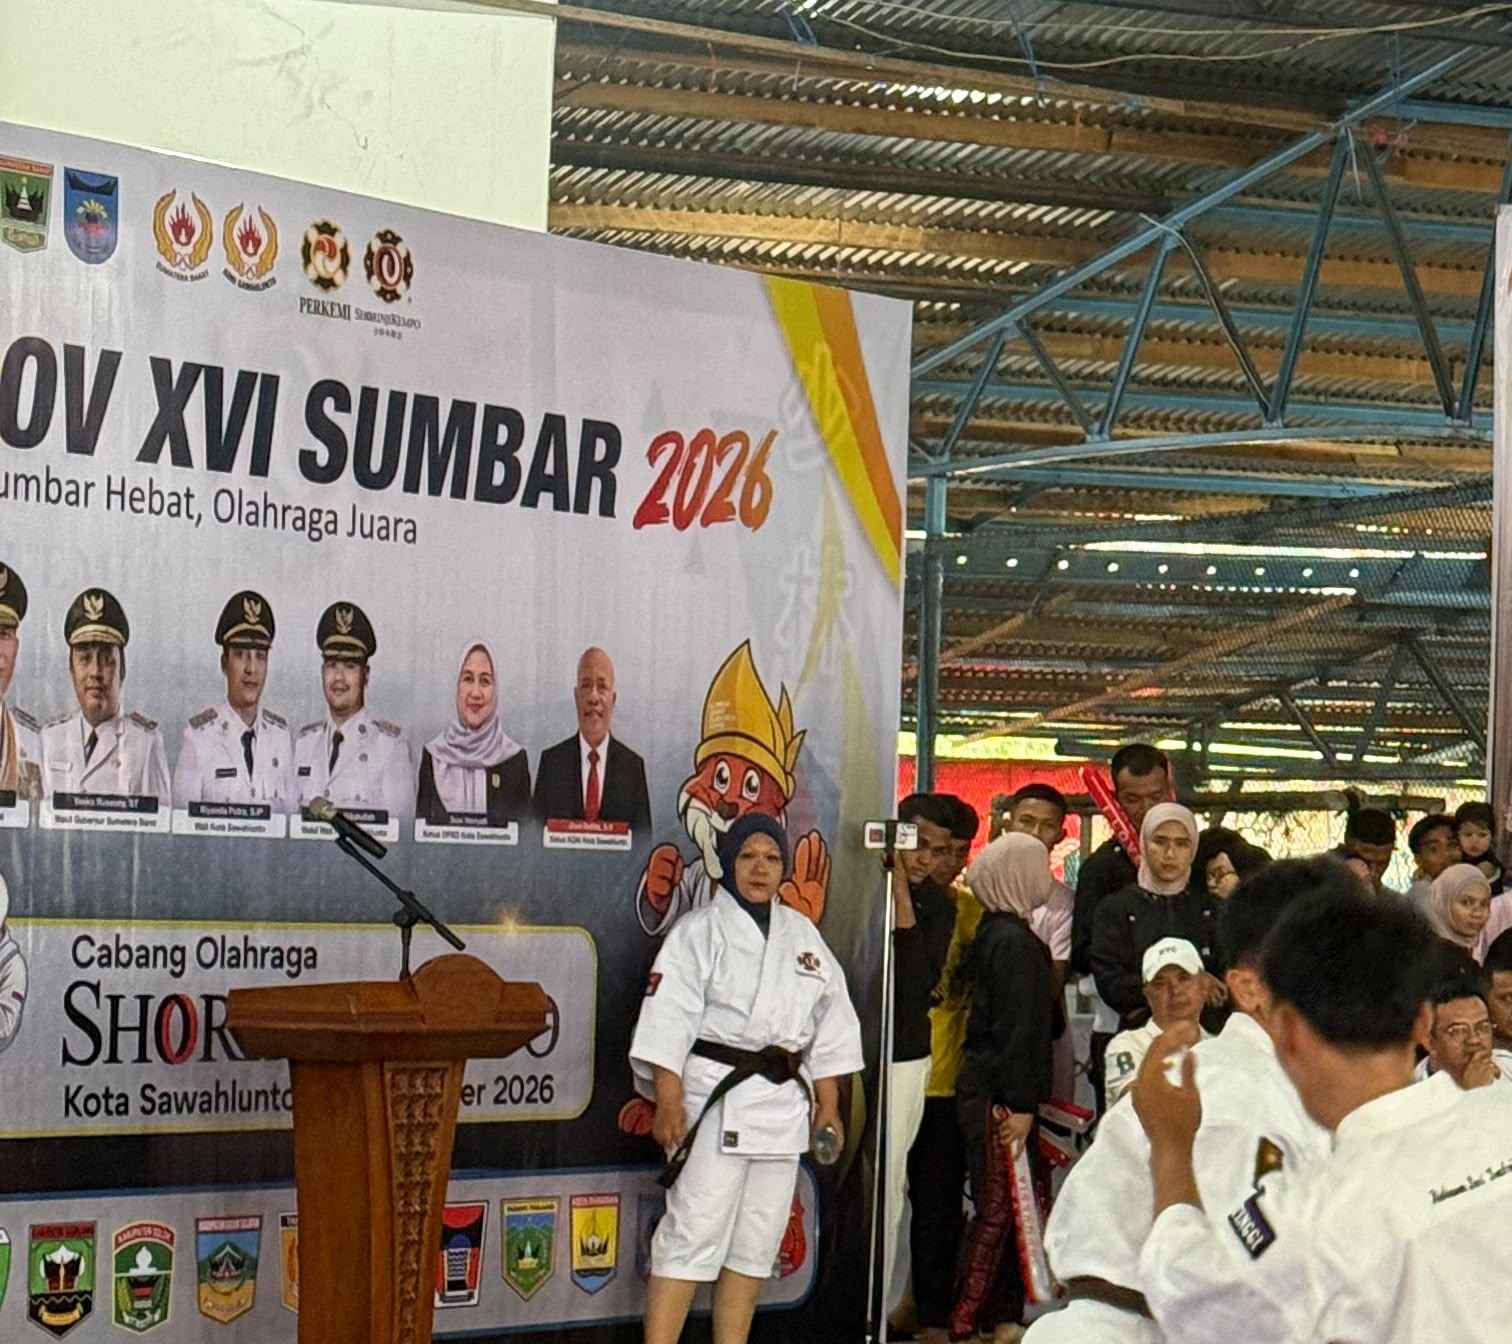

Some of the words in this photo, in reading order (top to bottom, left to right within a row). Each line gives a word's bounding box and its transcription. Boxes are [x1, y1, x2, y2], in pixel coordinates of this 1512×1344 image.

[135, 355, 280, 478] XVI
[298, 378, 622, 519] SUMBAR
[632, 426, 780, 533] 2026
[105, 473, 202, 528] Hebat,
[213, 487, 338, 543] Olahraga
[346, 503, 418, 545] Juara
[71, 934, 186, 978] Cabang
[196, 936, 318, 977] Olahraga
[64, 1085, 130, 1120] Kota
[492, 1074, 554, 1106] 2026
